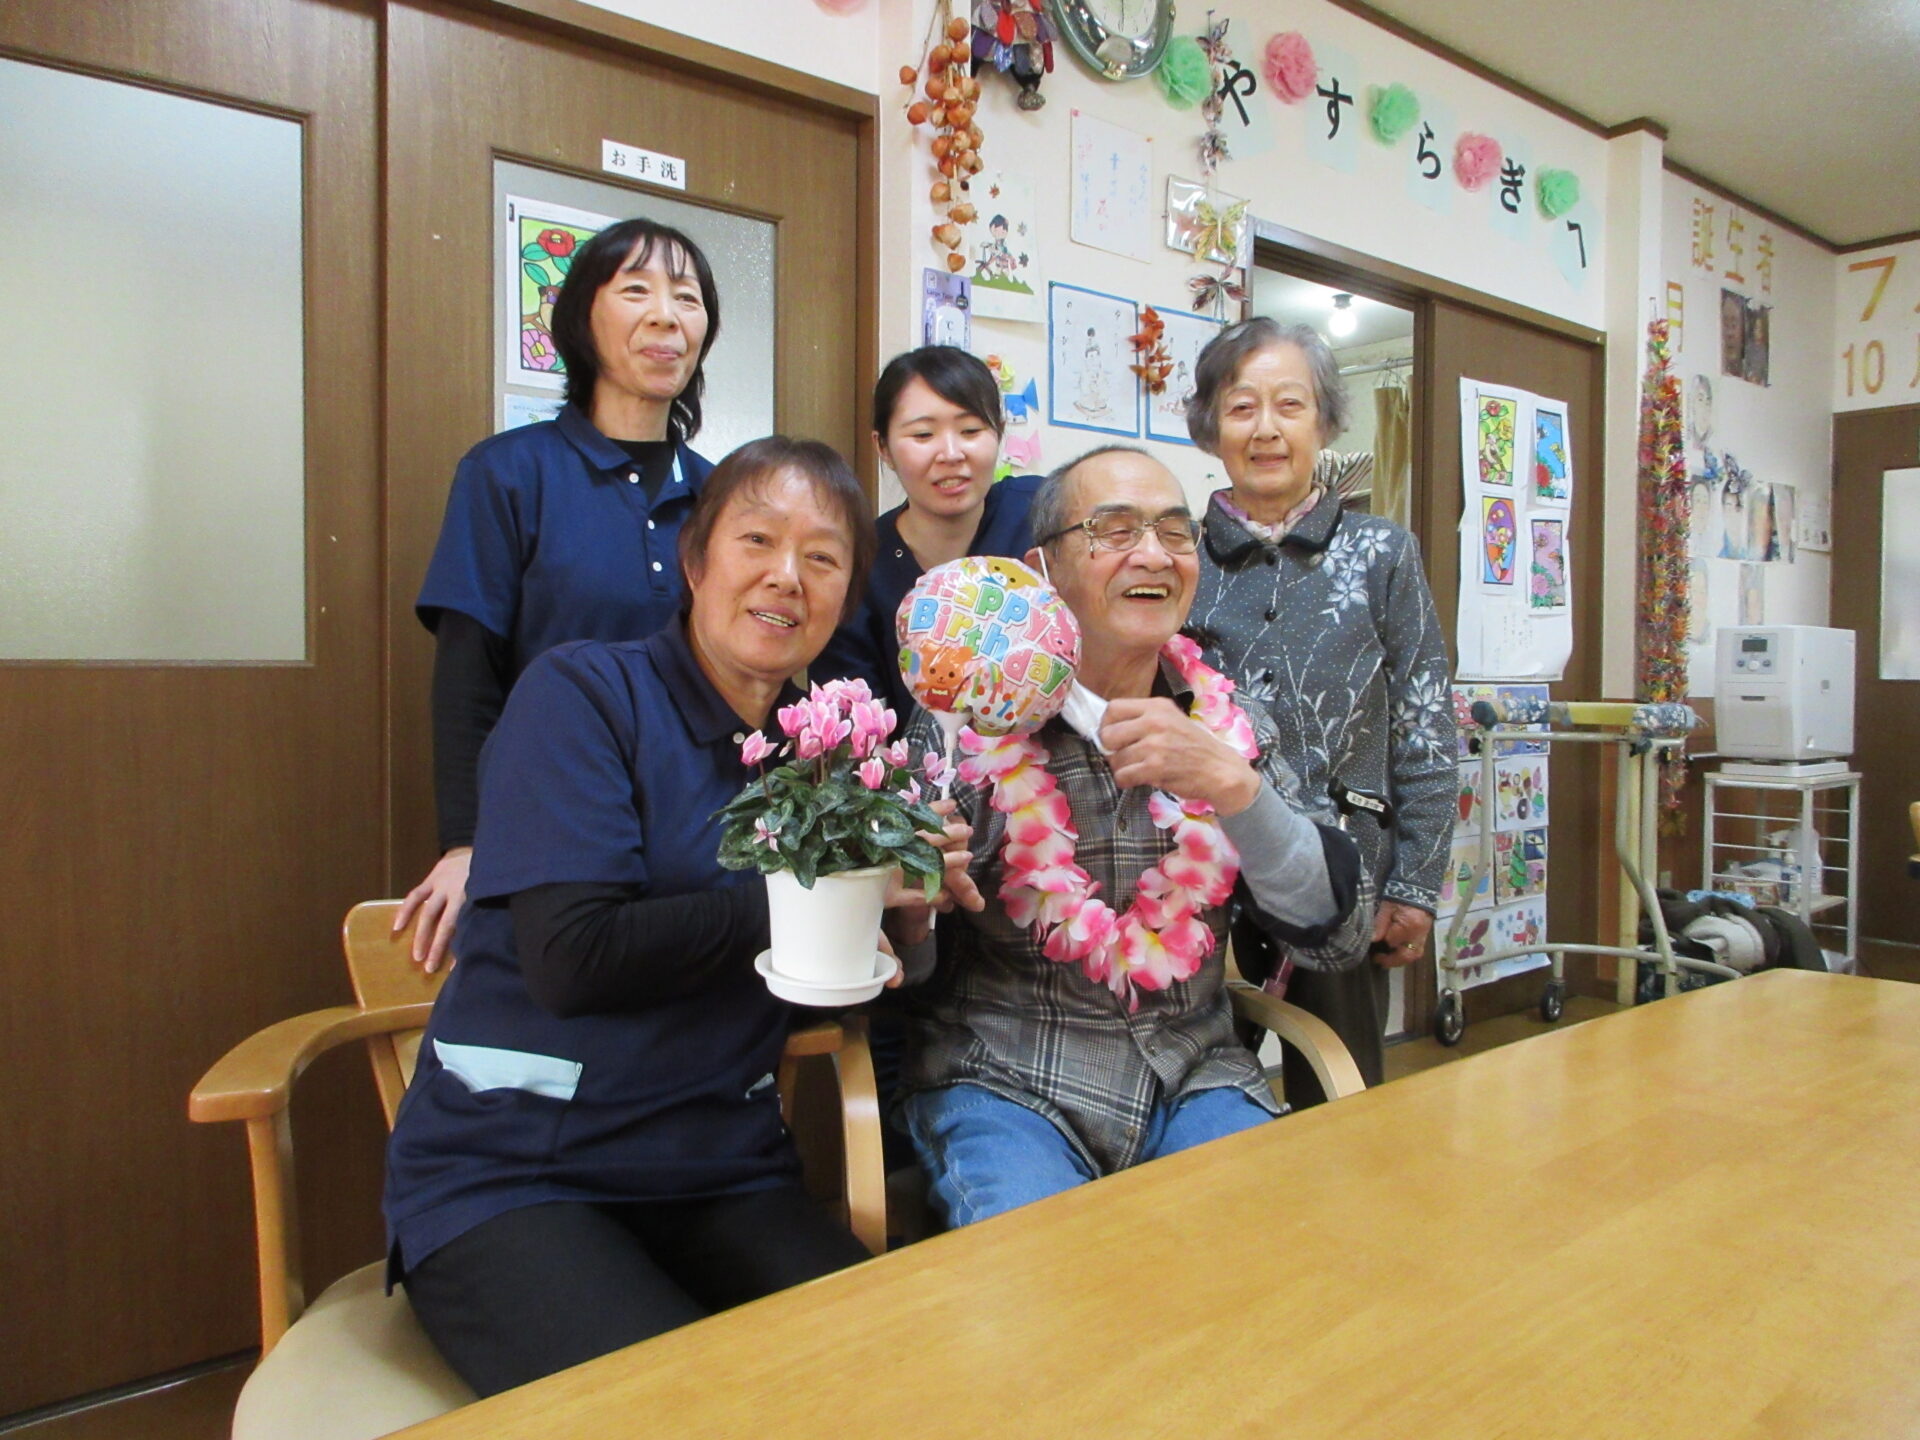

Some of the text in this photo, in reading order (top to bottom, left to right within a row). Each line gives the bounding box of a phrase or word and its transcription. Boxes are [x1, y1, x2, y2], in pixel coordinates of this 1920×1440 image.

[612, 149, 678, 181] お手洗
[1848, 255, 1920, 322] 7
[926, 571, 1050, 642] Happy
